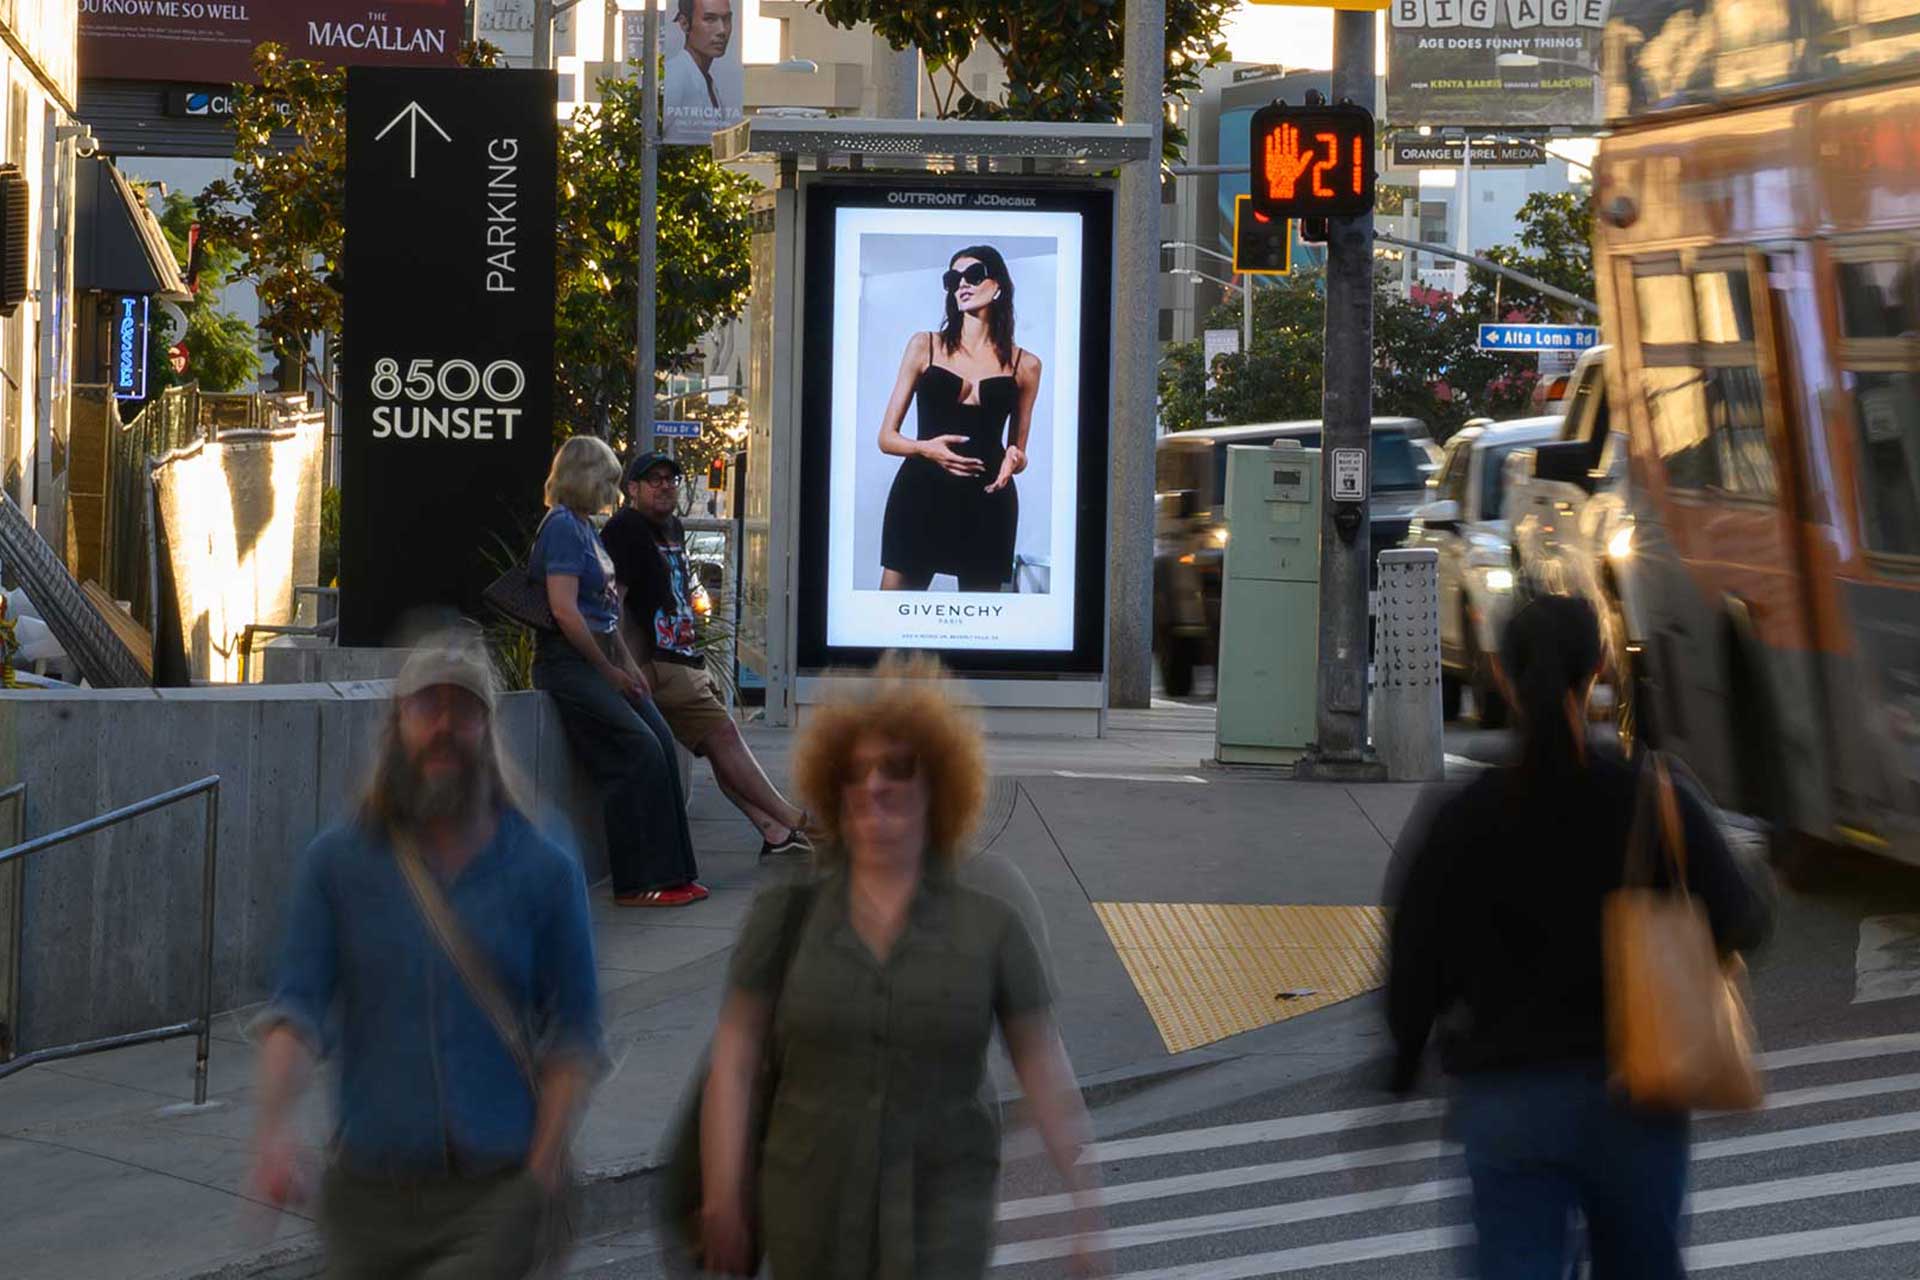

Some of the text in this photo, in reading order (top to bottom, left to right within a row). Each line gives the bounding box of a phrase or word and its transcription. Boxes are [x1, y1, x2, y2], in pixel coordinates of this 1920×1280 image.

[78, 0, 249, 21] OU KNOW ME SO WELL
[368, 12, 387, 21] THE
[1401, 0, 1600, 22] BIG AGE
[308, 22, 447, 53] MACALLAN
[1418, 37, 1583, 49] AGE DOES FUNNY THINGS
[1312, 133, 1362, 197] 21
[1401, 149, 1451, 160] ORANGE
[1501, 149, 1539, 160] MEDIA
[888, 192, 1037, 207] OUTFRONT JCDecaux
[486, 138, 518, 292] PARKING
[1504, 331, 1592, 346] Alta Loma Rd
[371, 357, 526, 402] 8500
[372, 406, 522, 440] SUNSET
[898, 604, 1003, 617] GIVENCHY
